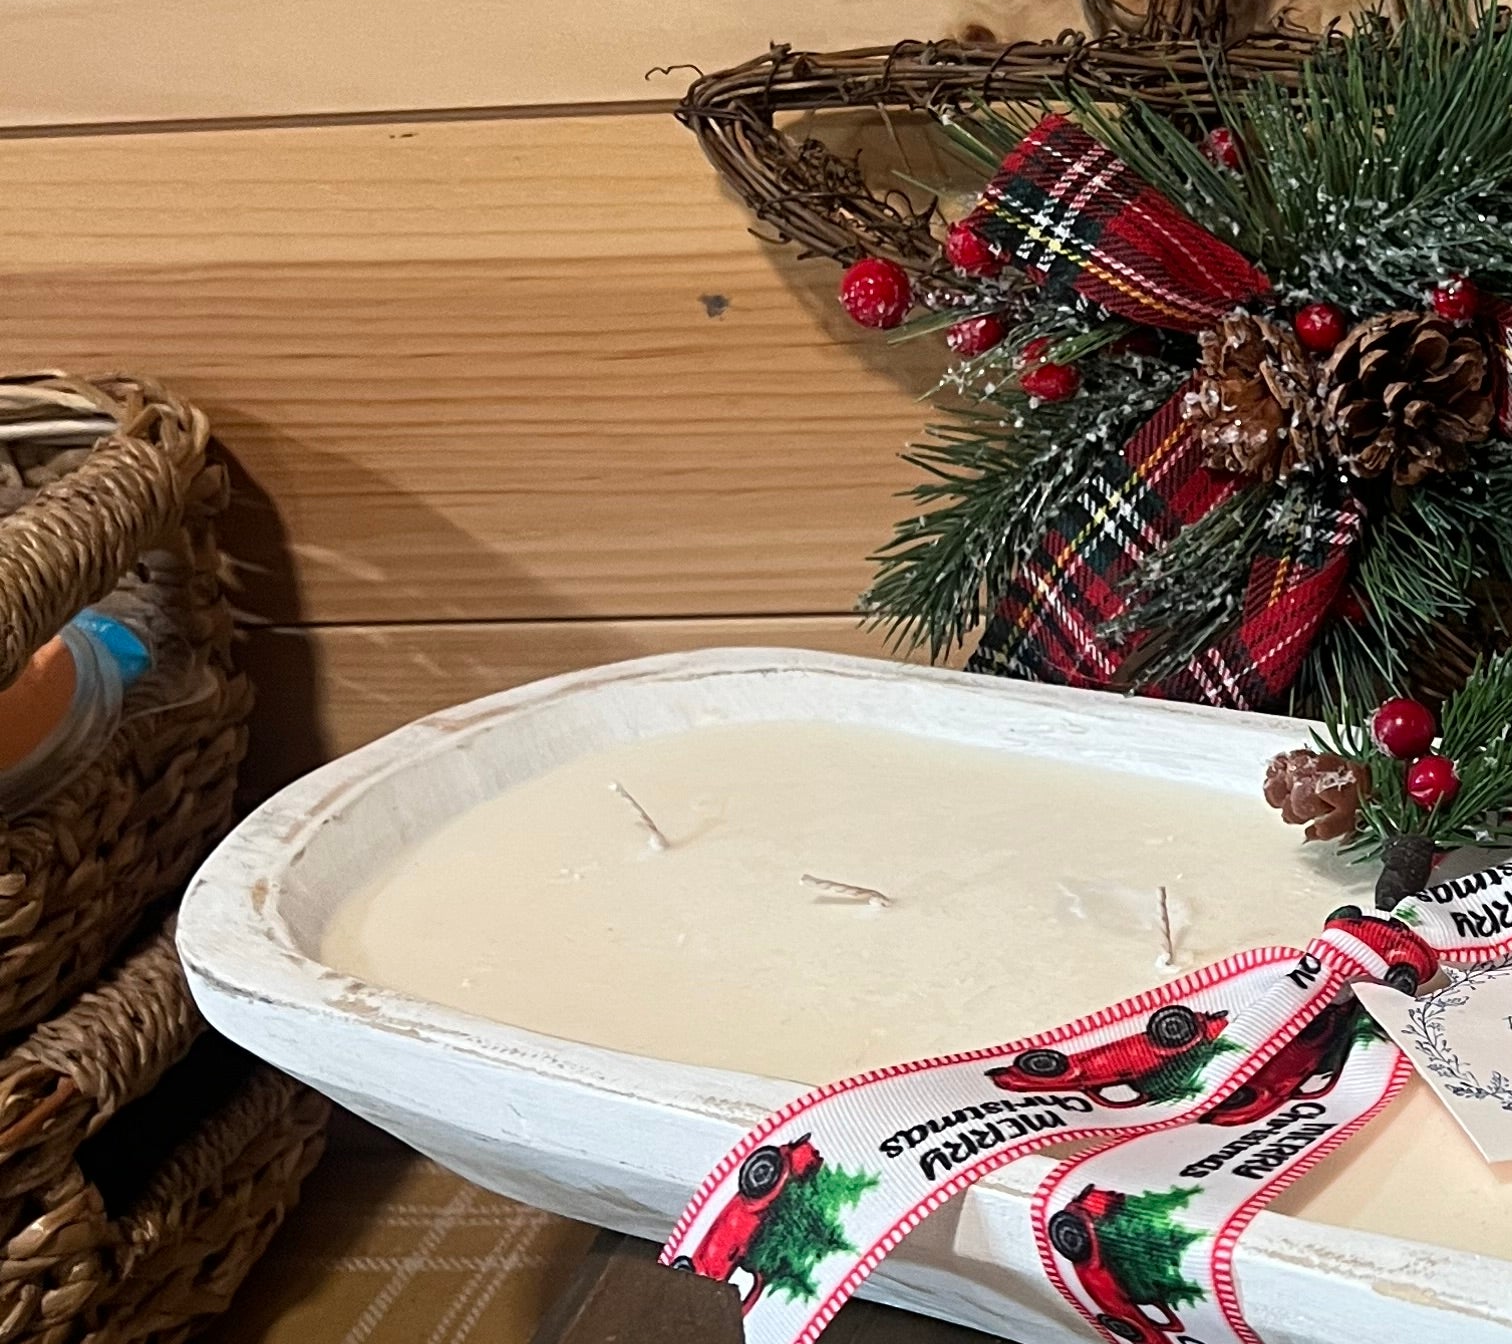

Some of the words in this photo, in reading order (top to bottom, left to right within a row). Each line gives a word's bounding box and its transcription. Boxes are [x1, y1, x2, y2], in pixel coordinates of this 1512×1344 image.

[879, 1094, 1094, 1158] Christmas
[919, 1110, 1067, 1181] MERRY
[1179, 1102, 1326, 1178] Christmas
[1232, 1122, 1340, 1180] MERRY
